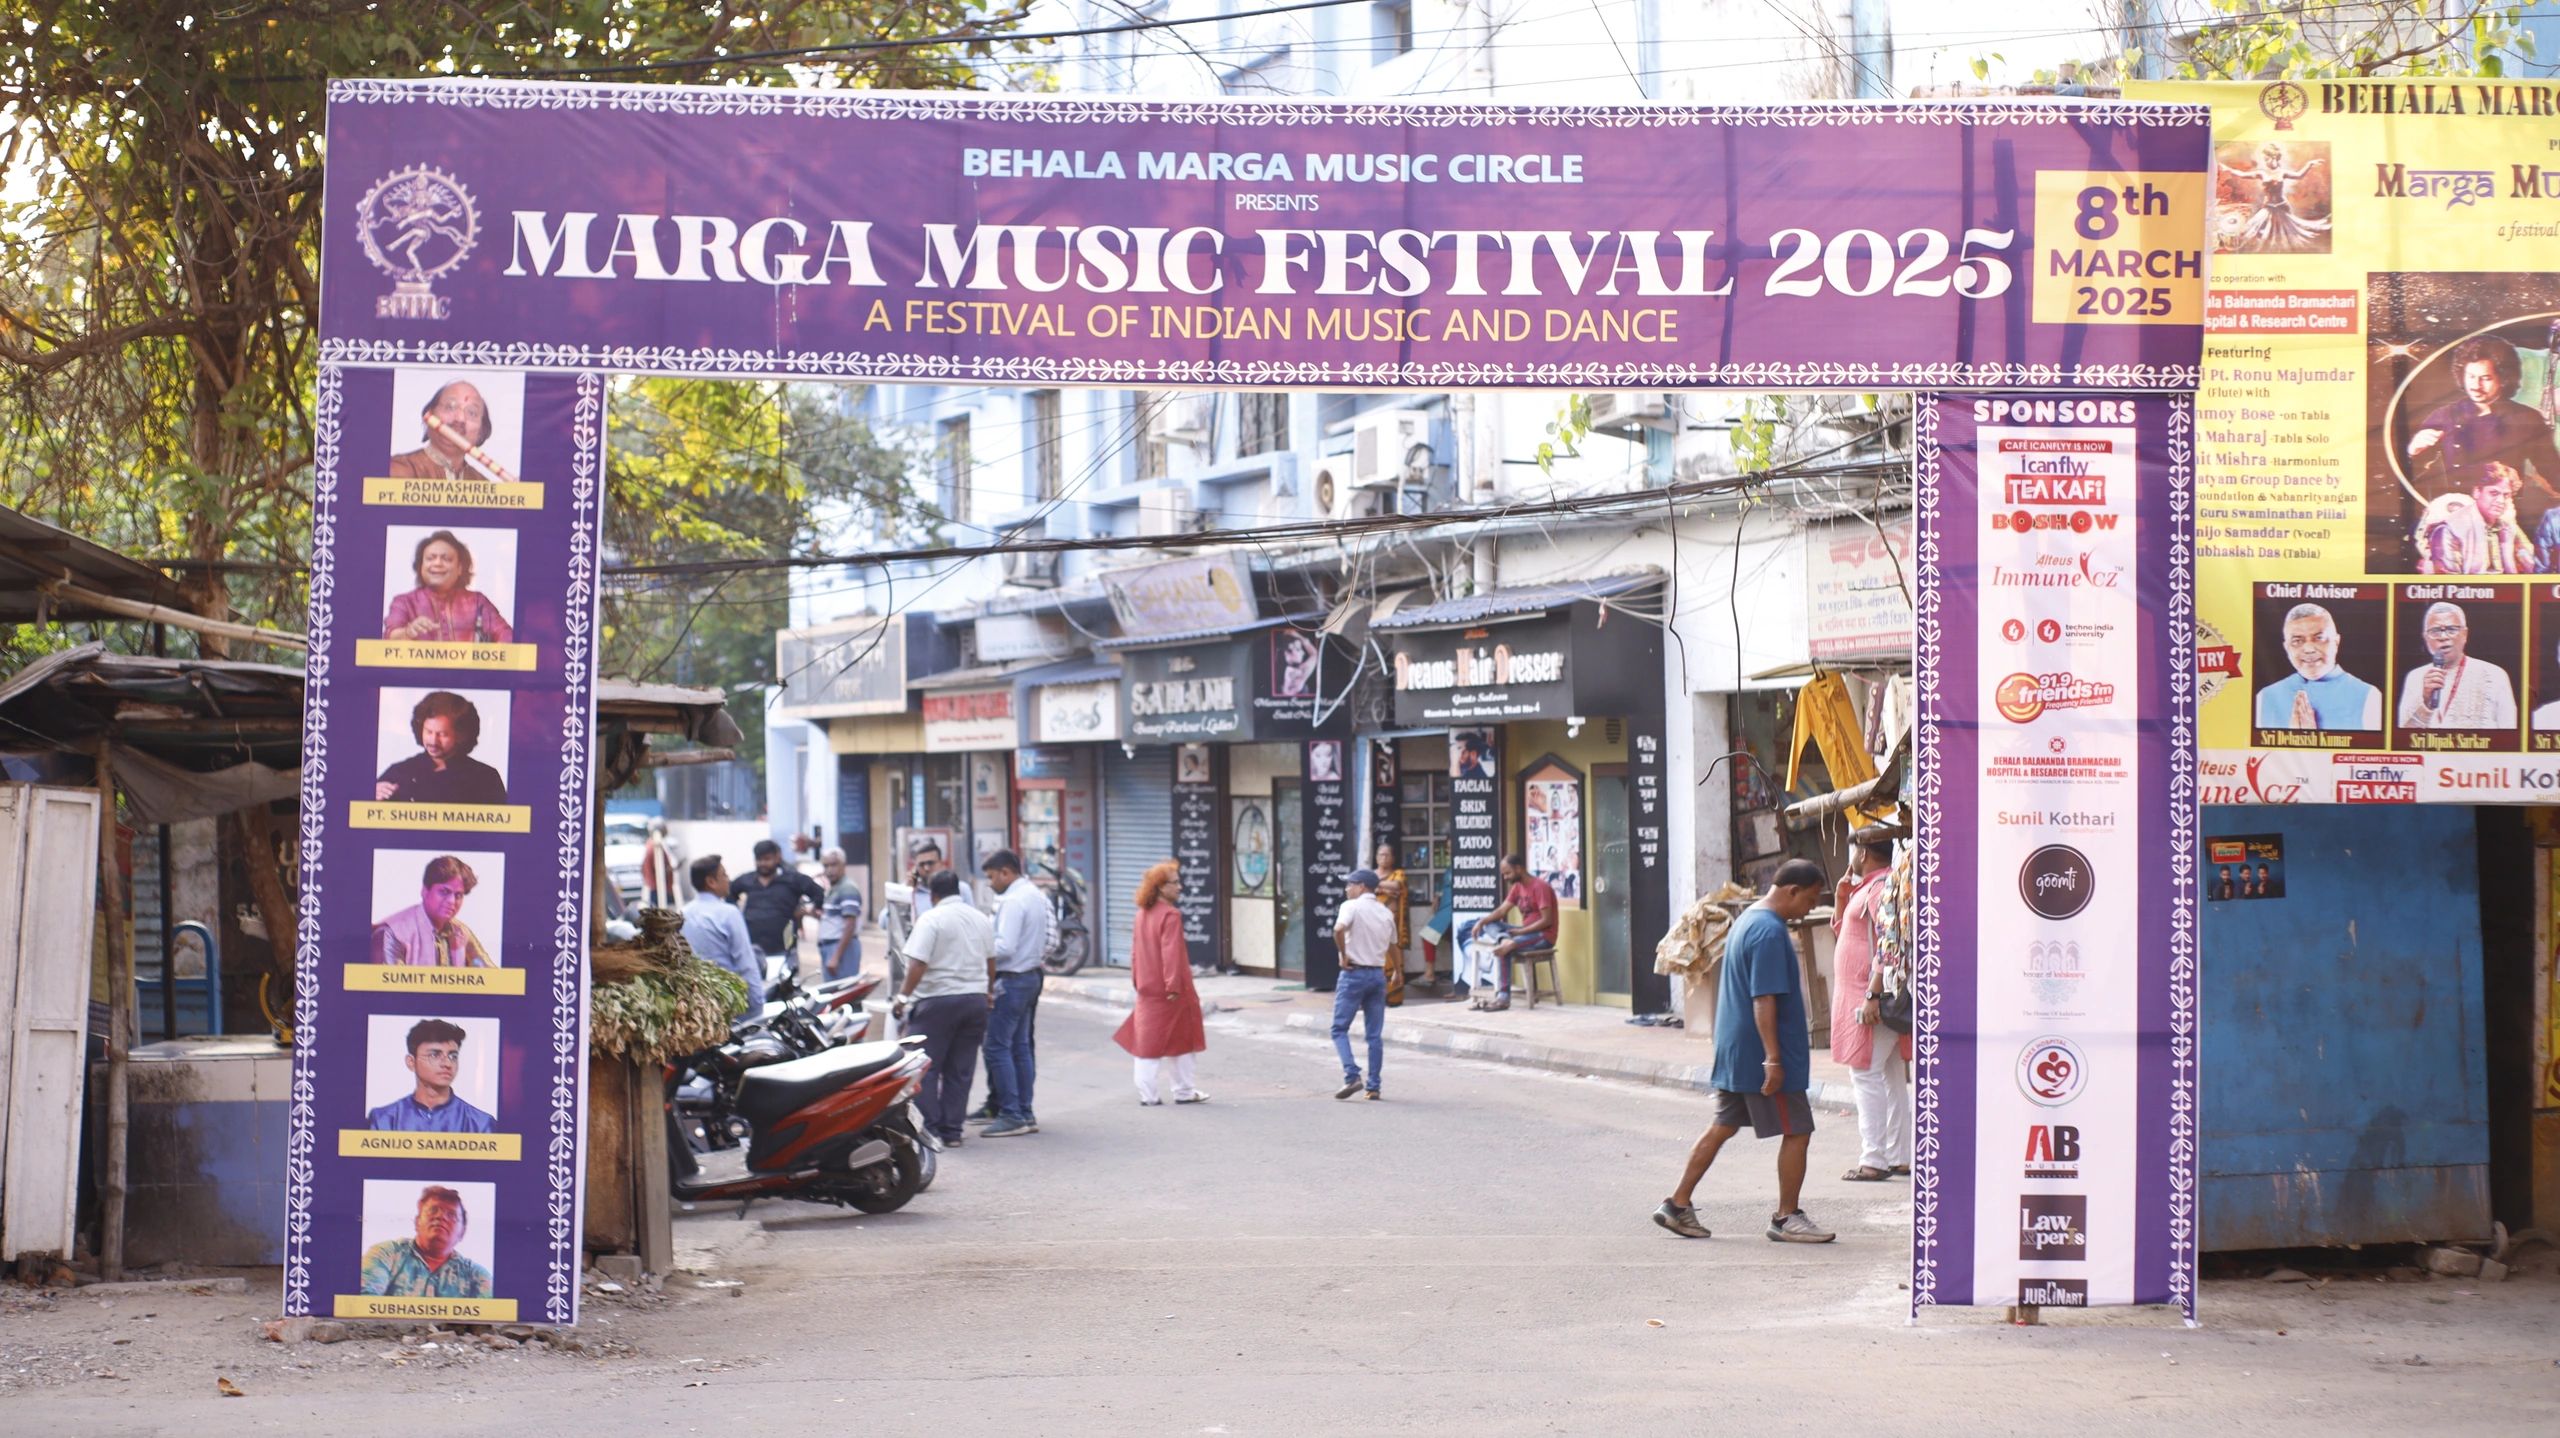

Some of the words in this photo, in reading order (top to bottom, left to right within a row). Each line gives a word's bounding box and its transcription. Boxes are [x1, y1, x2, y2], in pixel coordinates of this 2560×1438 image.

[2322, 84, 2465, 116] BEHALA
[2477, 85, 2560, 117] MAR
[963, 147, 1126, 179] BEHALA
[1138, 151, 1293, 181] MARGA
[1306, 153, 1438, 182] MUSIC
[1449, 154, 1584, 184] CIRCLE
[2374, 163, 2495, 211] Marga
[1235, 194, 1319, 212] PRESENTS
[2074, 182, 2170, 241] 8th
[2506, 220, 2560, 242] festival
[503, 210, 887, 287] MARGA
[915, 223, 1225, 295] MUSIC
[1255, 228, 1735, 298] FESTIVAL
[1764, 228, 2015, 299] 2025
[2050, 249, 2201, 279] MARCH
[2224, 275, 2265, 285] operation
[2268, 275, 2286, 283] with
[2077, 287, 2172, 315] 2025
[2225, 295, 2286, 309] Balananda
[2288, 295, 2356, 309] Bramachari
[864, 299, 892, 331] A
[905, 300, 1076, 337] FESTIVAL
[1087, 304, 1139, 338] OF
[1150, 305, 1292, 340] INDIAN
[1307, 308, 1431, 341] MUSIC
[1443, 309, 1531, 342] AND
[1545, 309, 1678, 343] DANCE
[2239, 315, 2249, 328] &
[2251, 314, 2306, 328] Research
[2309, 314, 2348, 328] Centre
[2208, 346, 2271, 360] Featuring
[2211, 369, 2229, 381] Pt.
[2234, 369, 2272, 381] Ronu
[2277, 367, 2355, 384] Majumdar
[2208, 387, 2243, 399] (Flute)
[2246, 387, 2271, 398] with
[1973, 399, 2136, 424] SPONSORS
[2242, 408, 2275, 420] Bose
[2005, 440, 2028, 450] CAFÉ
[2074, 442, 2081, 451] IS
[2083, 442, 2106, 451] NOW
[2206, 429, 2267, 446] Maharaj
[2306, 433, 2329, 444] Solo
[2216, 451, 2267, 466] Mishra
[404, 480, 498, 494] PADMASHREE
[2241, 475, 2280, 488] Group
[2284, 475, 2322, 486] Dance
[2326, 474, 2342, 488] by
[378, 492, 397, 504] PT.
[401, 492, 442, 505] RONU
[446, 493, 526, 507] MAJUMDER
[2009, 479, 2049, 504] TEA
[2200, 508, 2229, 519] Guru
[2225, 526, 2290, 538] Samaddar
[2259, 546, 2280, 558] Das
[1992, 566, 2082, 588] Immune
[2266, 583, 2303, 599] Chief
[2306, 583, 2358, 599] Advisor
[2407, 584, 2446, 599] Chief
[2446, 585, 2495, 599] Patron
[2065, 630, 2105, 639] university
[2094, 623, 2114, 631] india
[384, 647, 403, 660] PT.
[408, 648, 467, 661] TANMOY
[472, 649, 507, 662] BOSE
[1394, 652, 1456, 691] Dreams
[1456, 646, 1495, 688] Hair
[1494, 644, 1563, 685] Dresser
[2039, 673, 2072, 689] 91.9
[2019, 680, 2093, 704] friends
[2093, 683, 2113, 697] fm
[2260, 730, 2275, 746] Sri
[2319, 732, 2353, 747] Kumar
[2410, 733, 2427, 749] Sri
[2456, 733, 2492, 749] Sarkar
[1986, 767, 2022, 777] HOSPITAL
[2030, 767, 2068, 777] RESEARCH
[2070, 768, 2097, 778] CENTRE
[2438, 767, 2511, 788] Sunil
[1454, 779, 1492, 793] FACIAL
[367, 809, 386, 821] PT.
[390, 809, 438, 823] SHUBH
[442, 811, 512, 825] MAHARAJ
[1997, 811, 2044, 826] Sunil
[2049, 811, 2115, 826] Kothari
[382, 971, 426, 985] SUMIT
[430, 972, 485, 986] MISHRA
[360, 1137, 413, 1151] AGNIJO
[416, 1138, 498, 1153] SAMADDAR
[2025, 1125, 2080, 1161] AB
[2022, 1208, 2073, 1231] Law
[368, 1302, 448, 1316] SUBHASISH
[452, 1304, 481, 1317] DAS
